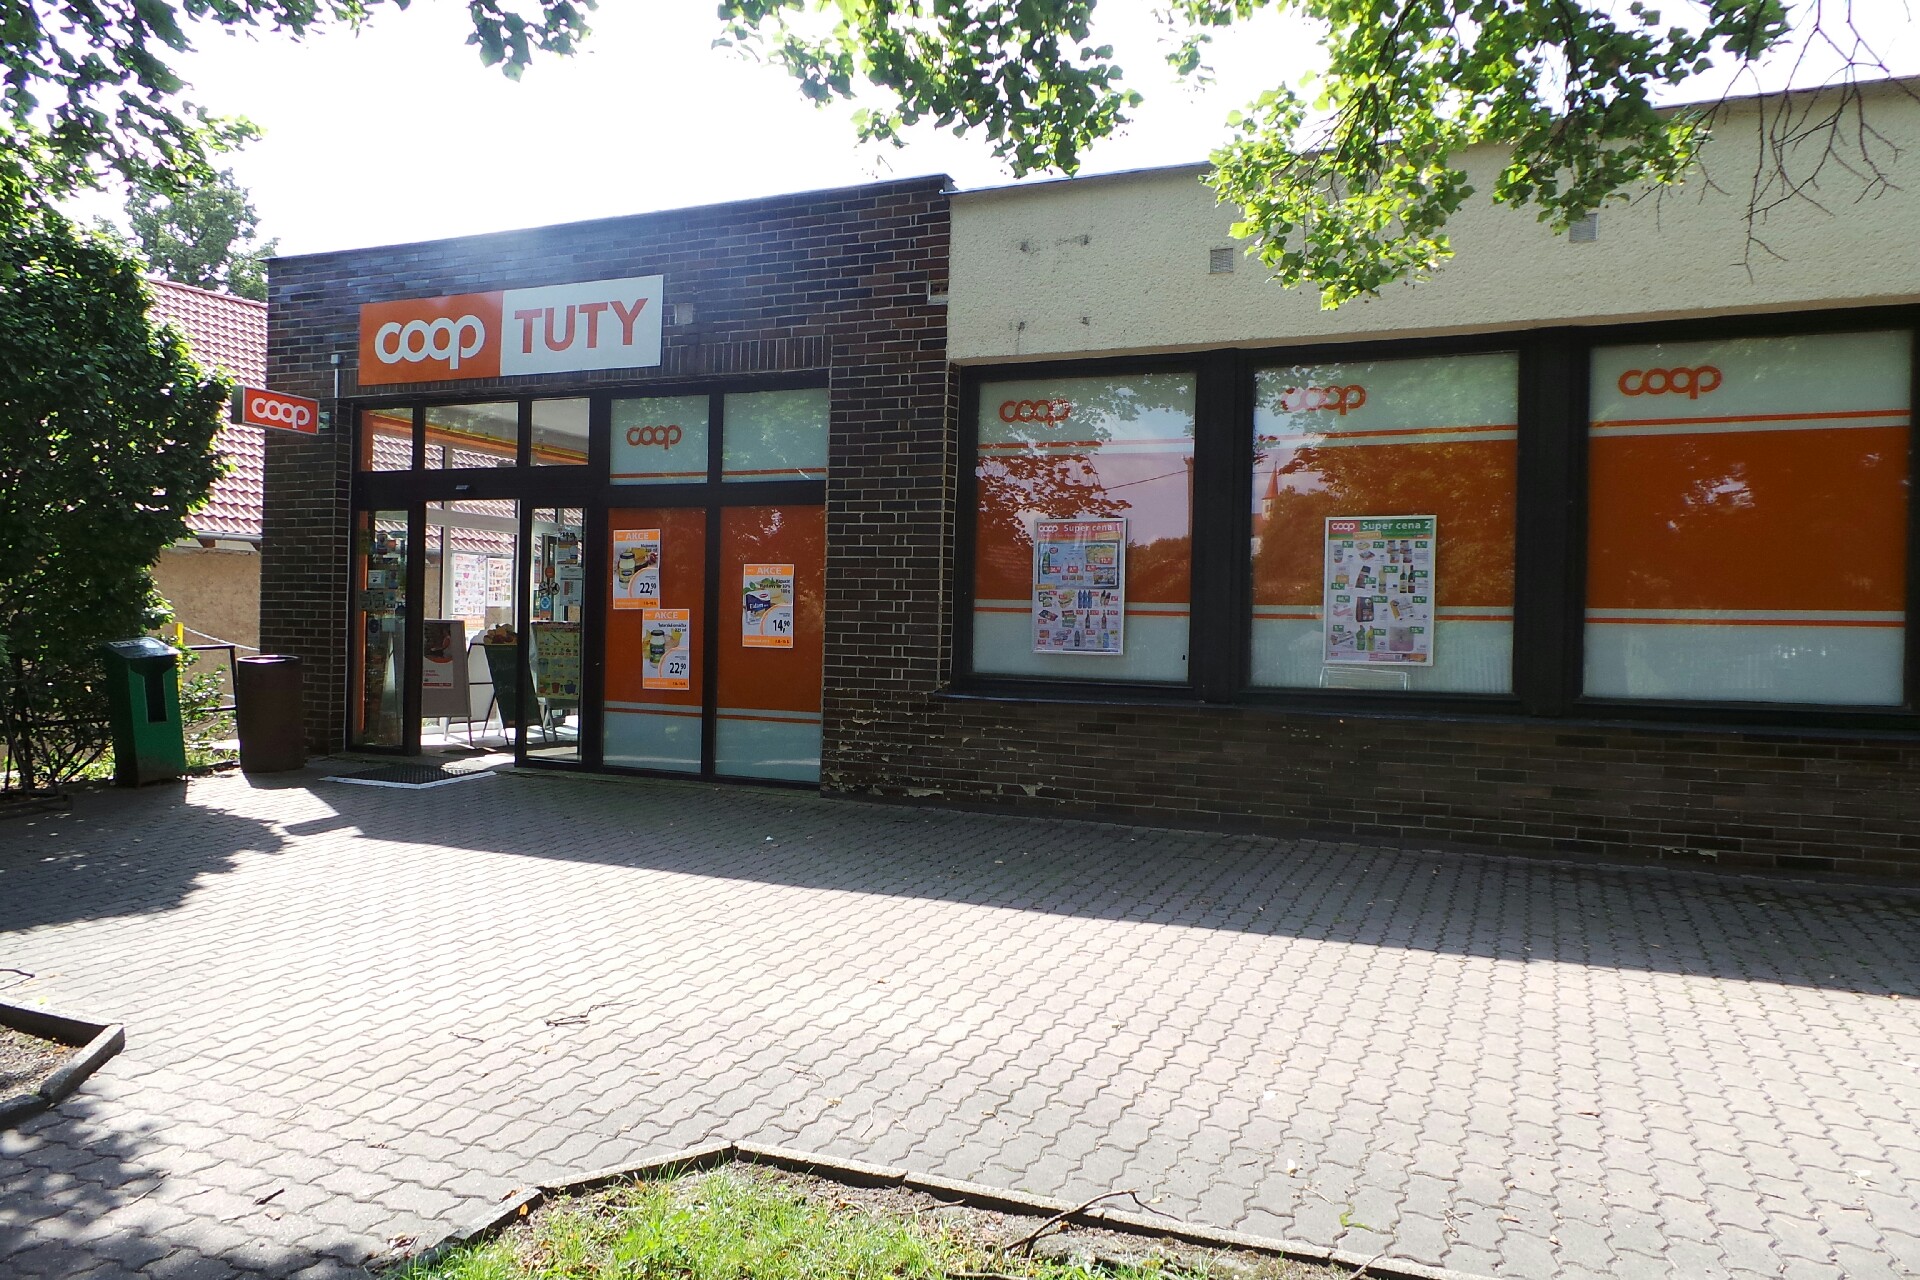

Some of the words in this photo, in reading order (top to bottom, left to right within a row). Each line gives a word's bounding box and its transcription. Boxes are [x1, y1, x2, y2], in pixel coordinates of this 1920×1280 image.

[375, 314, 486, 370] coop
[514, 298, 649, 354] TUTY
[1618, 365, 1722, 400] coop
[1280, 384, 1367, 416] coop
[251, 397, 311, 429] coop
[999, 399, 1072, 428] coop
[626, 424, 682, 450] coop
[1039, 525, 1059, 534] coop
[1063, 524, 1090, 534] Super
[1092, 524, 1113, 532] cena
[1116, 523, 1120, 531] 1
[1332, 523, 1356, 532] coop
[1362, 522, 1394, 531] Super
[1396, 521, 1422, 530] cena
[1425, 521, 1432, 529] 2
[625, 532, 649, 540] AKCE
[756, 567, 782, 575] AKCE
[640, 582, 657, 596] 22,90
[654, 611, 679, 619] AKCE
[773, 619, 791, 634] 14,90
[669, 662, 687, 676] 22,90
